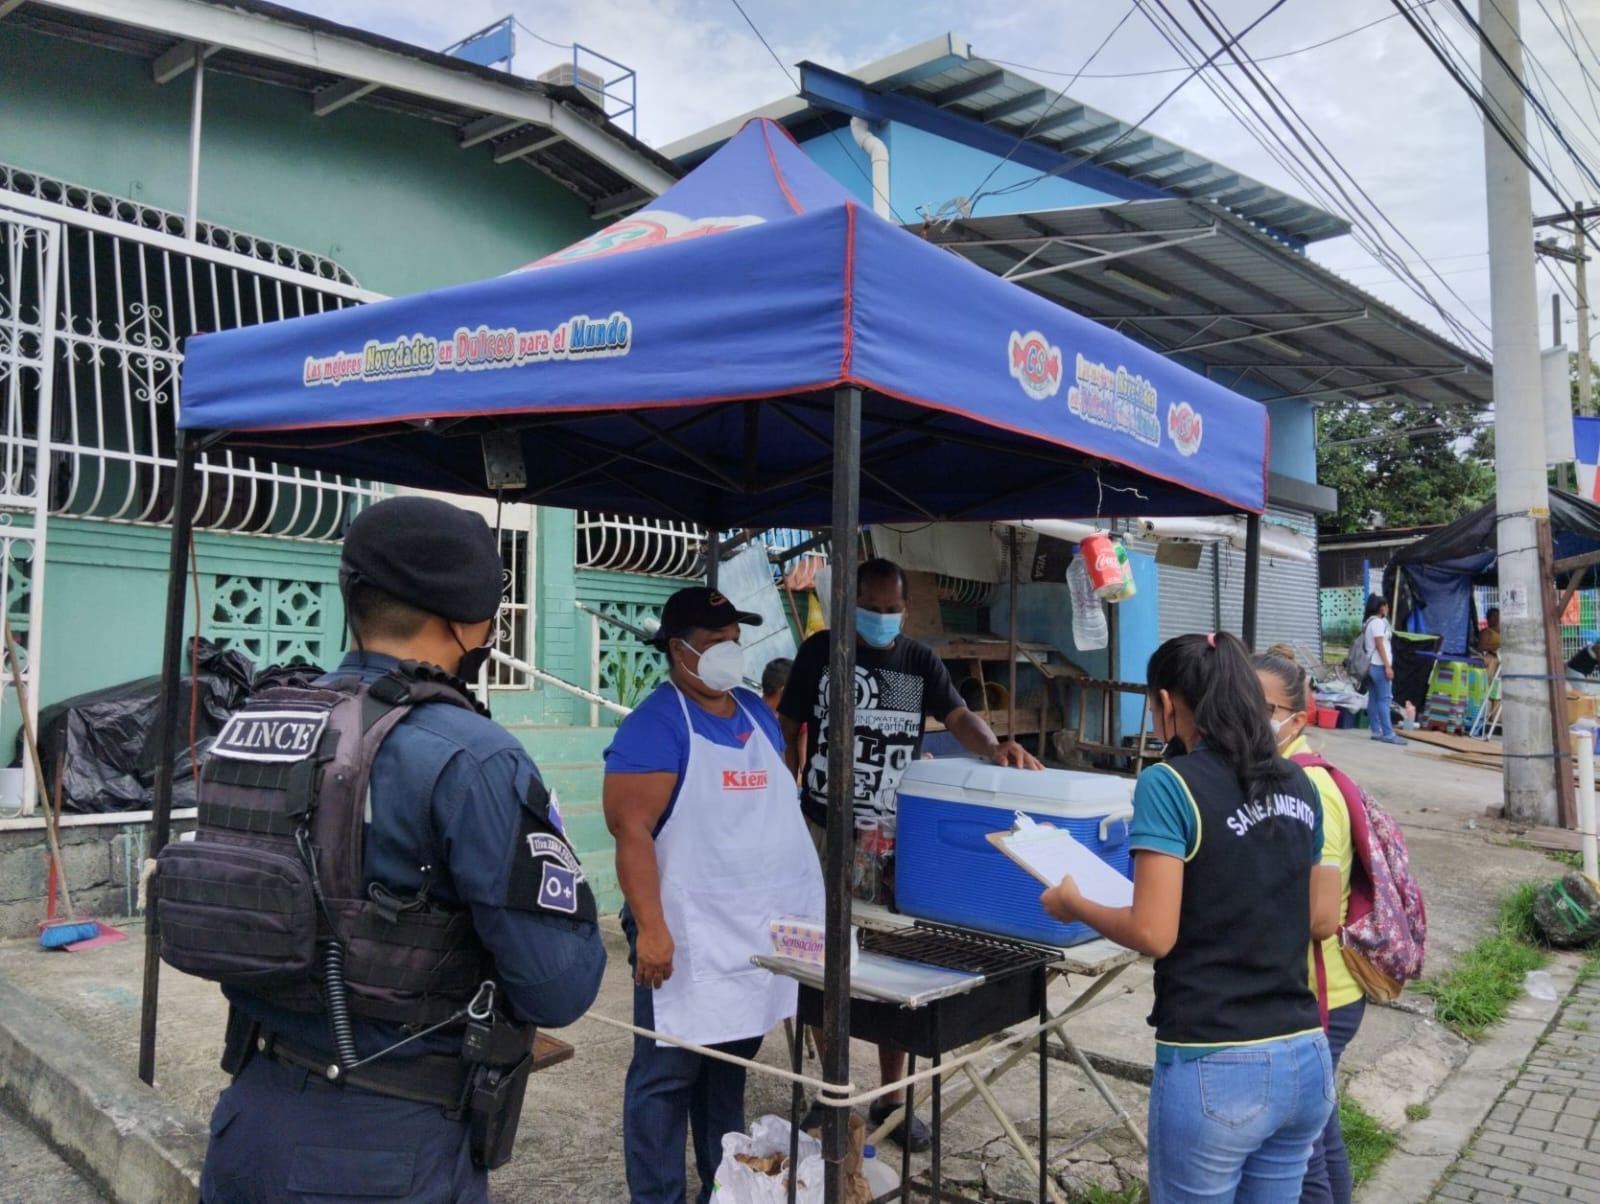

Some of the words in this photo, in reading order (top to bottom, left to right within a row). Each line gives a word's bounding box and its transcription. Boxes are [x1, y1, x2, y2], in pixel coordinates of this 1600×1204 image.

[305, 357, 321, 382] Las
[323, 355, 362, 382] mejores
[364, 338, 435, 377] Novedades
[438, 343, 453, 364] en
[455, 330, 515, 366] Dulces
[518, 333, 550, 360] para
[553, 326, 566, 353] el
[569, 316, 628, 353] Mundo
[225, 720, 316, 750] LINCE
